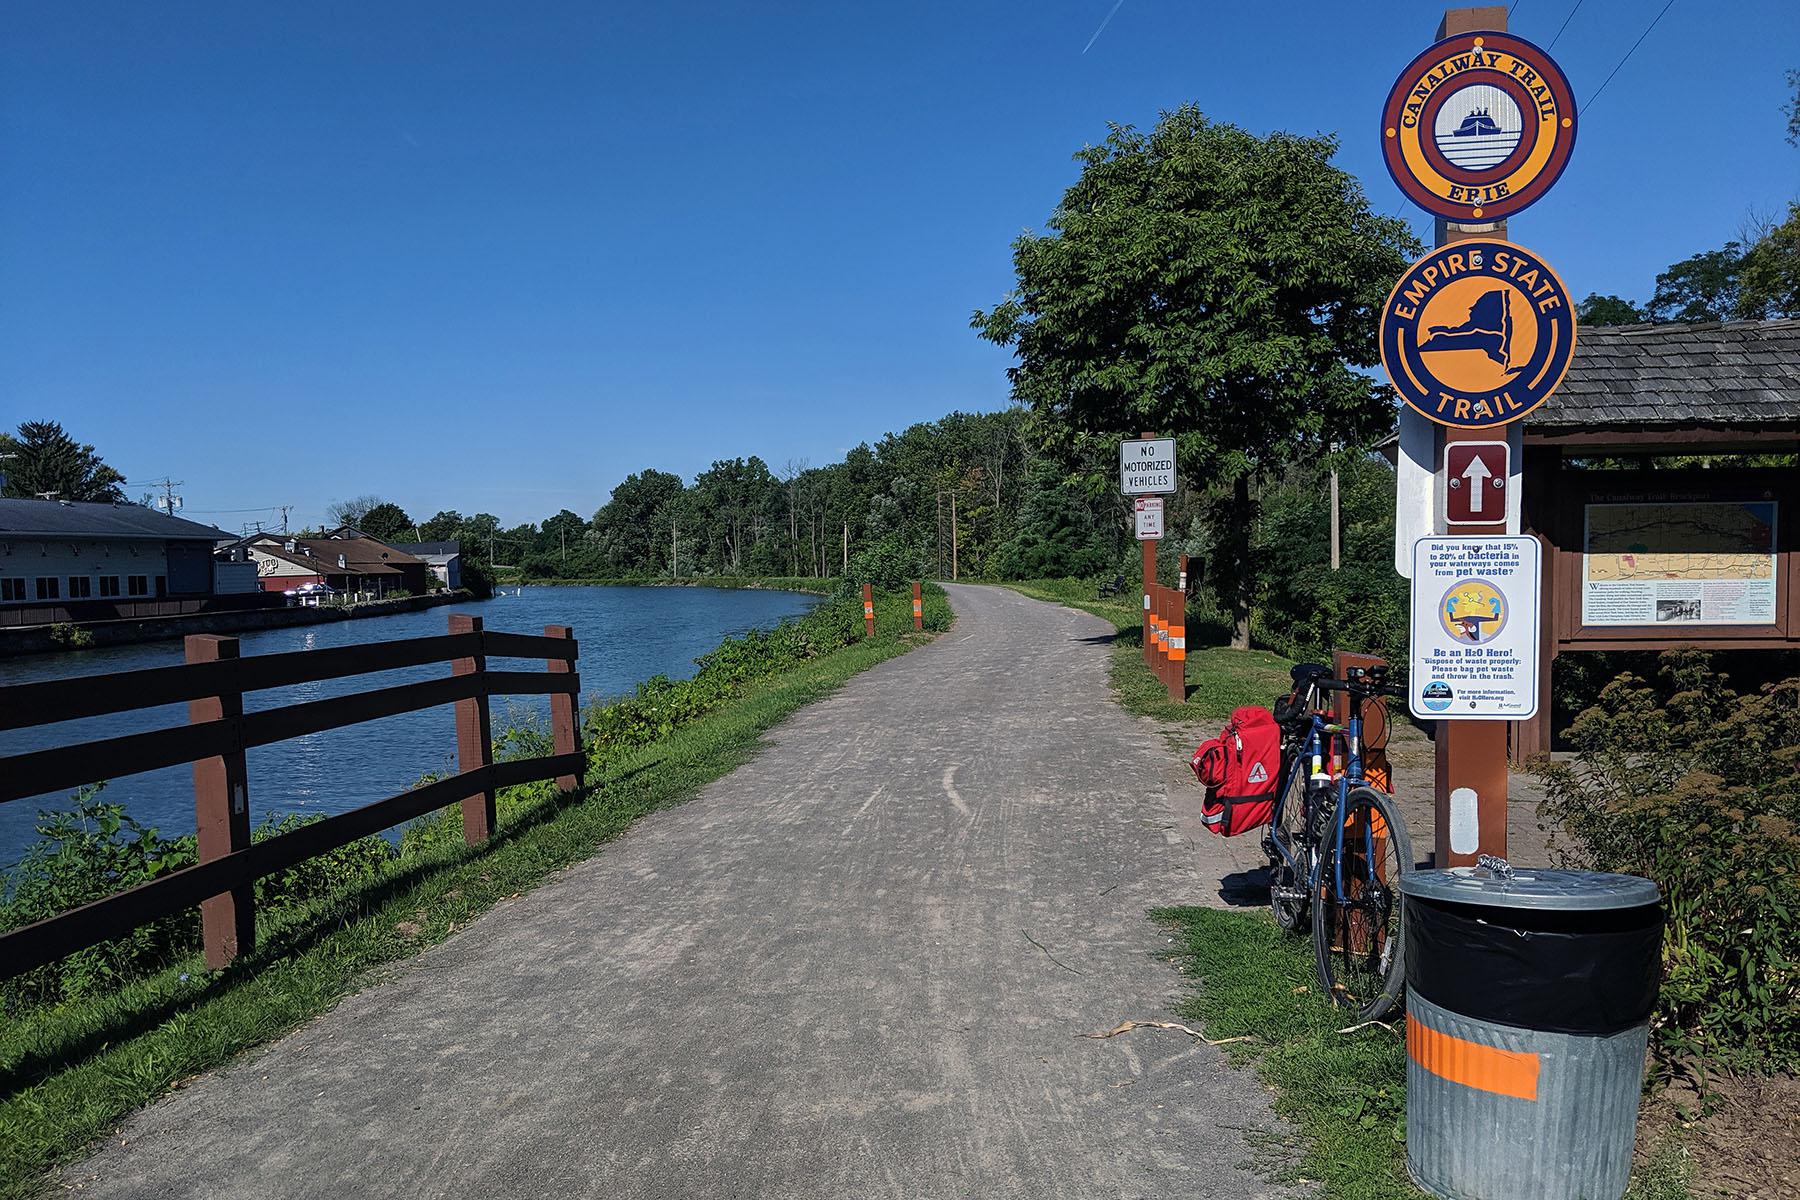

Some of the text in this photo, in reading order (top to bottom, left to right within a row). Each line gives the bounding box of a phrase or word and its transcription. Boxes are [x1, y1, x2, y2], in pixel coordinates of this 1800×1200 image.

[1402, 53, 1556, 129] CANALWAY TRAIL
[1447, 182, 1511, 202] ERIE
[1394, 250, 1562, 320] EMPIRE STATE
[1436, 391, 1523, 420] TRAIL
[1140, 446, 1155, 457] NO
[1123, 460, 1172, 472] MOTORIZED
[1128, 475, 1168, 487] VEHICLES
[1467, 551, 1509, 560] bacteria
[1430, 561, 1447, 569] your
[1456, 568, 1473, 577] pet
[1476, 567, 1514, 576] waste?
[1433, 649, 1446, 657] Be
[1486, 649, 1513, 657] Hero!
